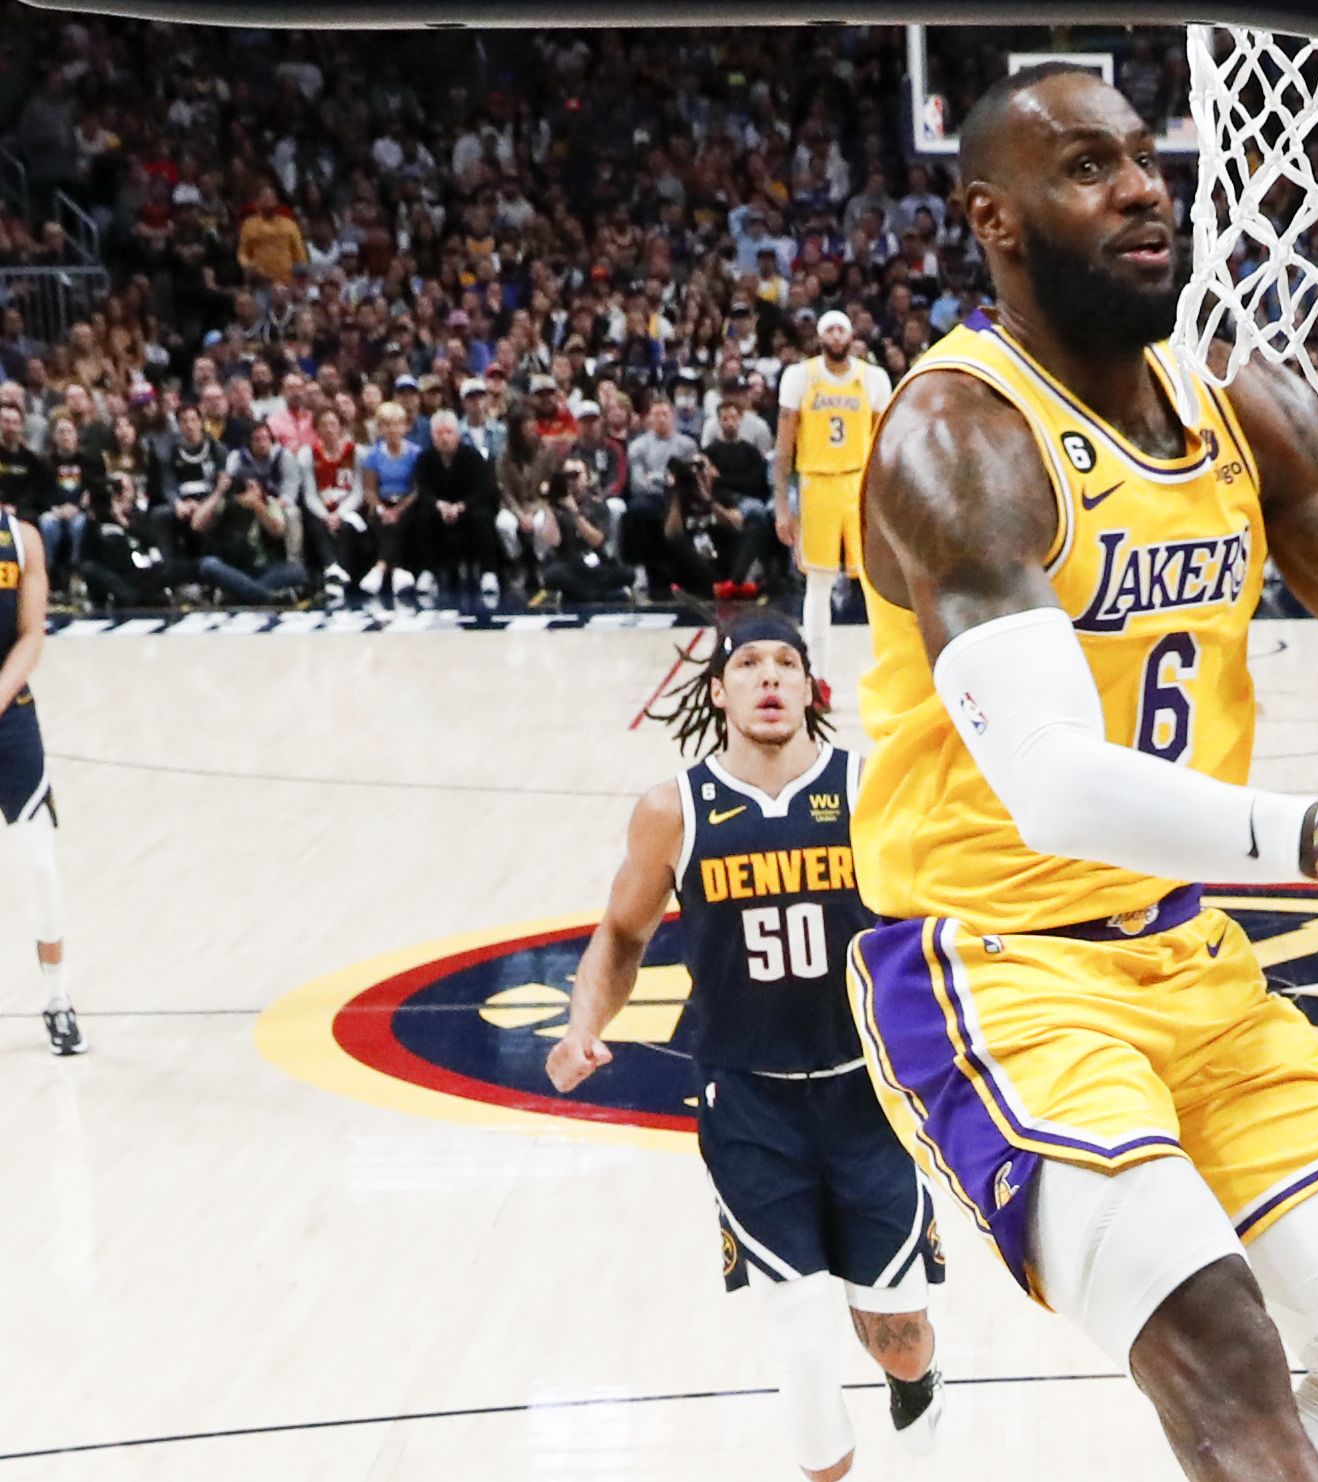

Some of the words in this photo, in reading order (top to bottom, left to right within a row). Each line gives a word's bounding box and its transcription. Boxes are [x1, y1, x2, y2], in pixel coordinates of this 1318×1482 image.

[829, 416, 845, 443] 3
[1064, 435, 1093, 470] 6
[1136, 630, 1198, 765] 6
[702, 782, 716, 801] 6
[809, 794, 840, 808] WU
[700, 846, 855, 902] DENVER
[741, 902, 829, 982] 50
